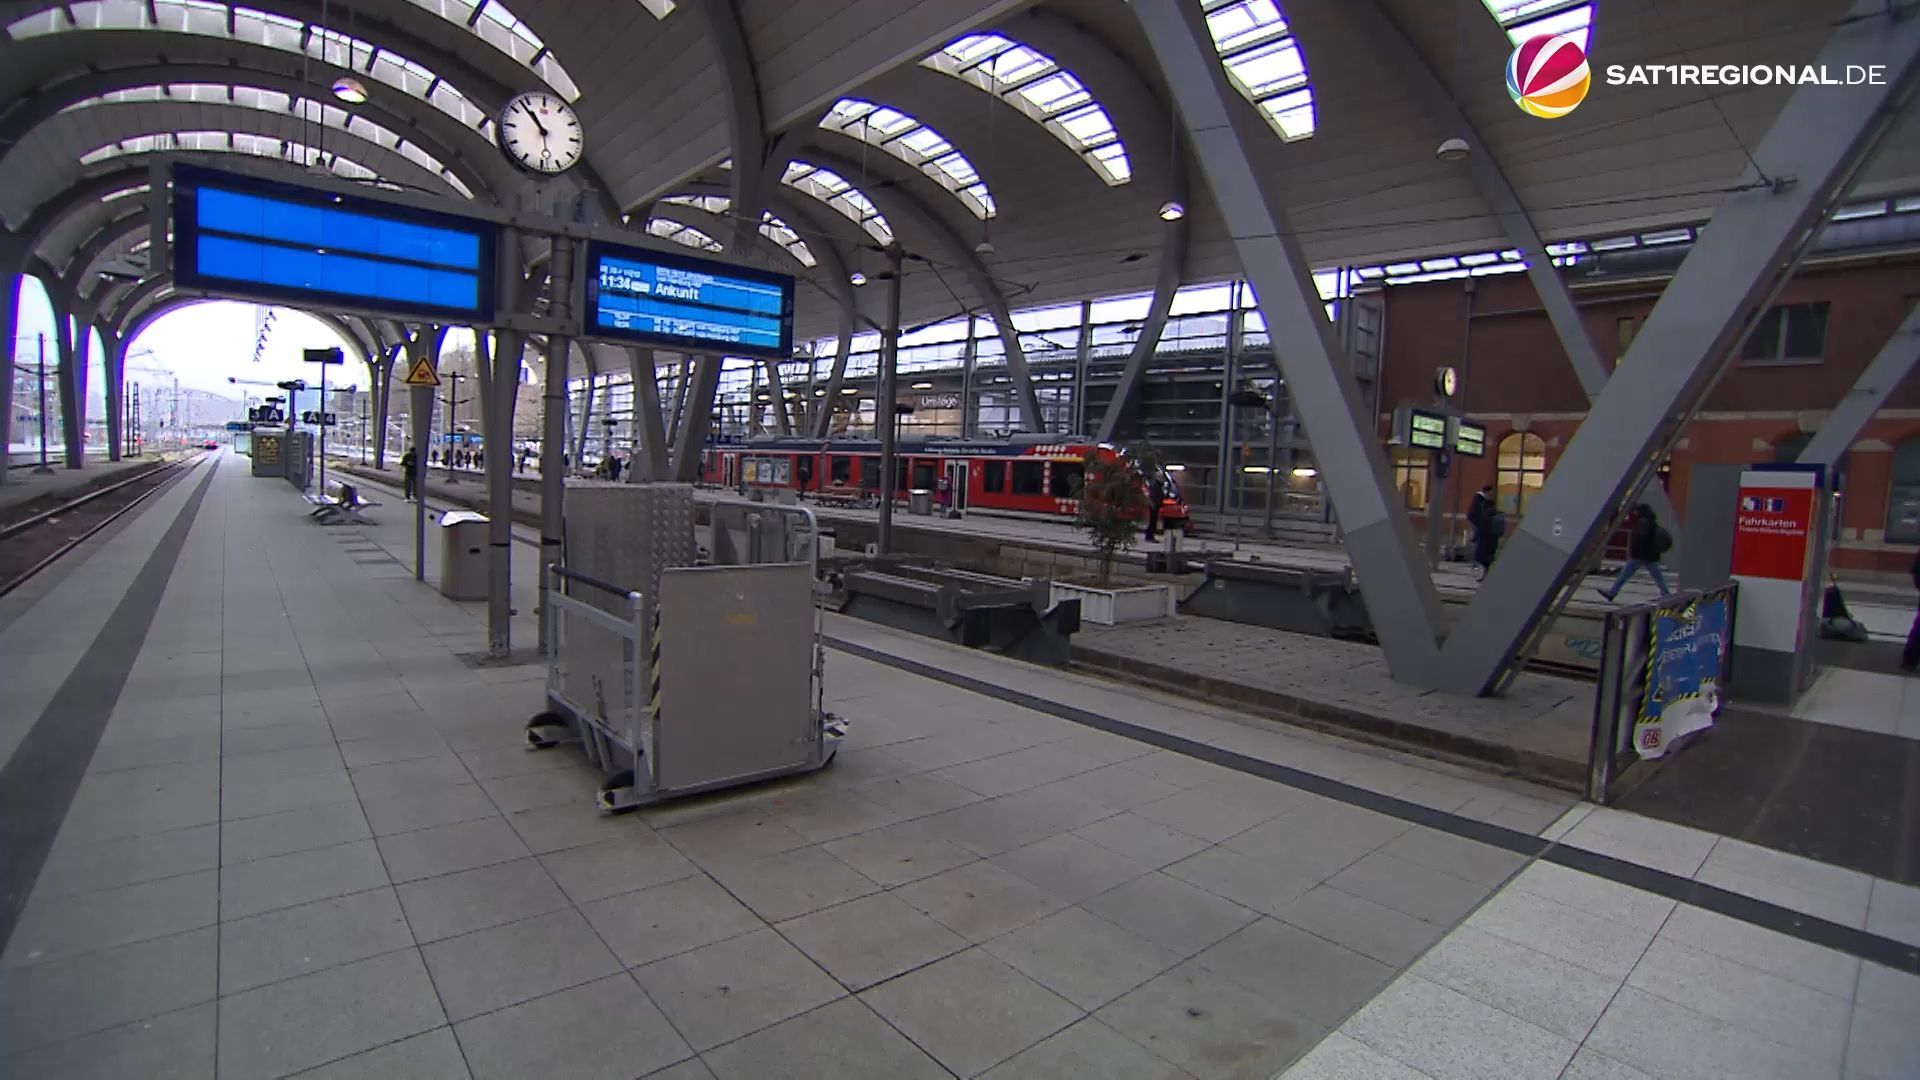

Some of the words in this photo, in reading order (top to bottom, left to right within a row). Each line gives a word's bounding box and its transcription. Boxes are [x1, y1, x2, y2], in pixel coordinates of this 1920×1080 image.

[600, 274, 631, 290] 11:34
[655, 283, 699, 300] Ankunft
[268, 409, 280, 420] A
[307, 412, 318, 422] A
[1739, 516, 1797, 529] Fahrkarten
